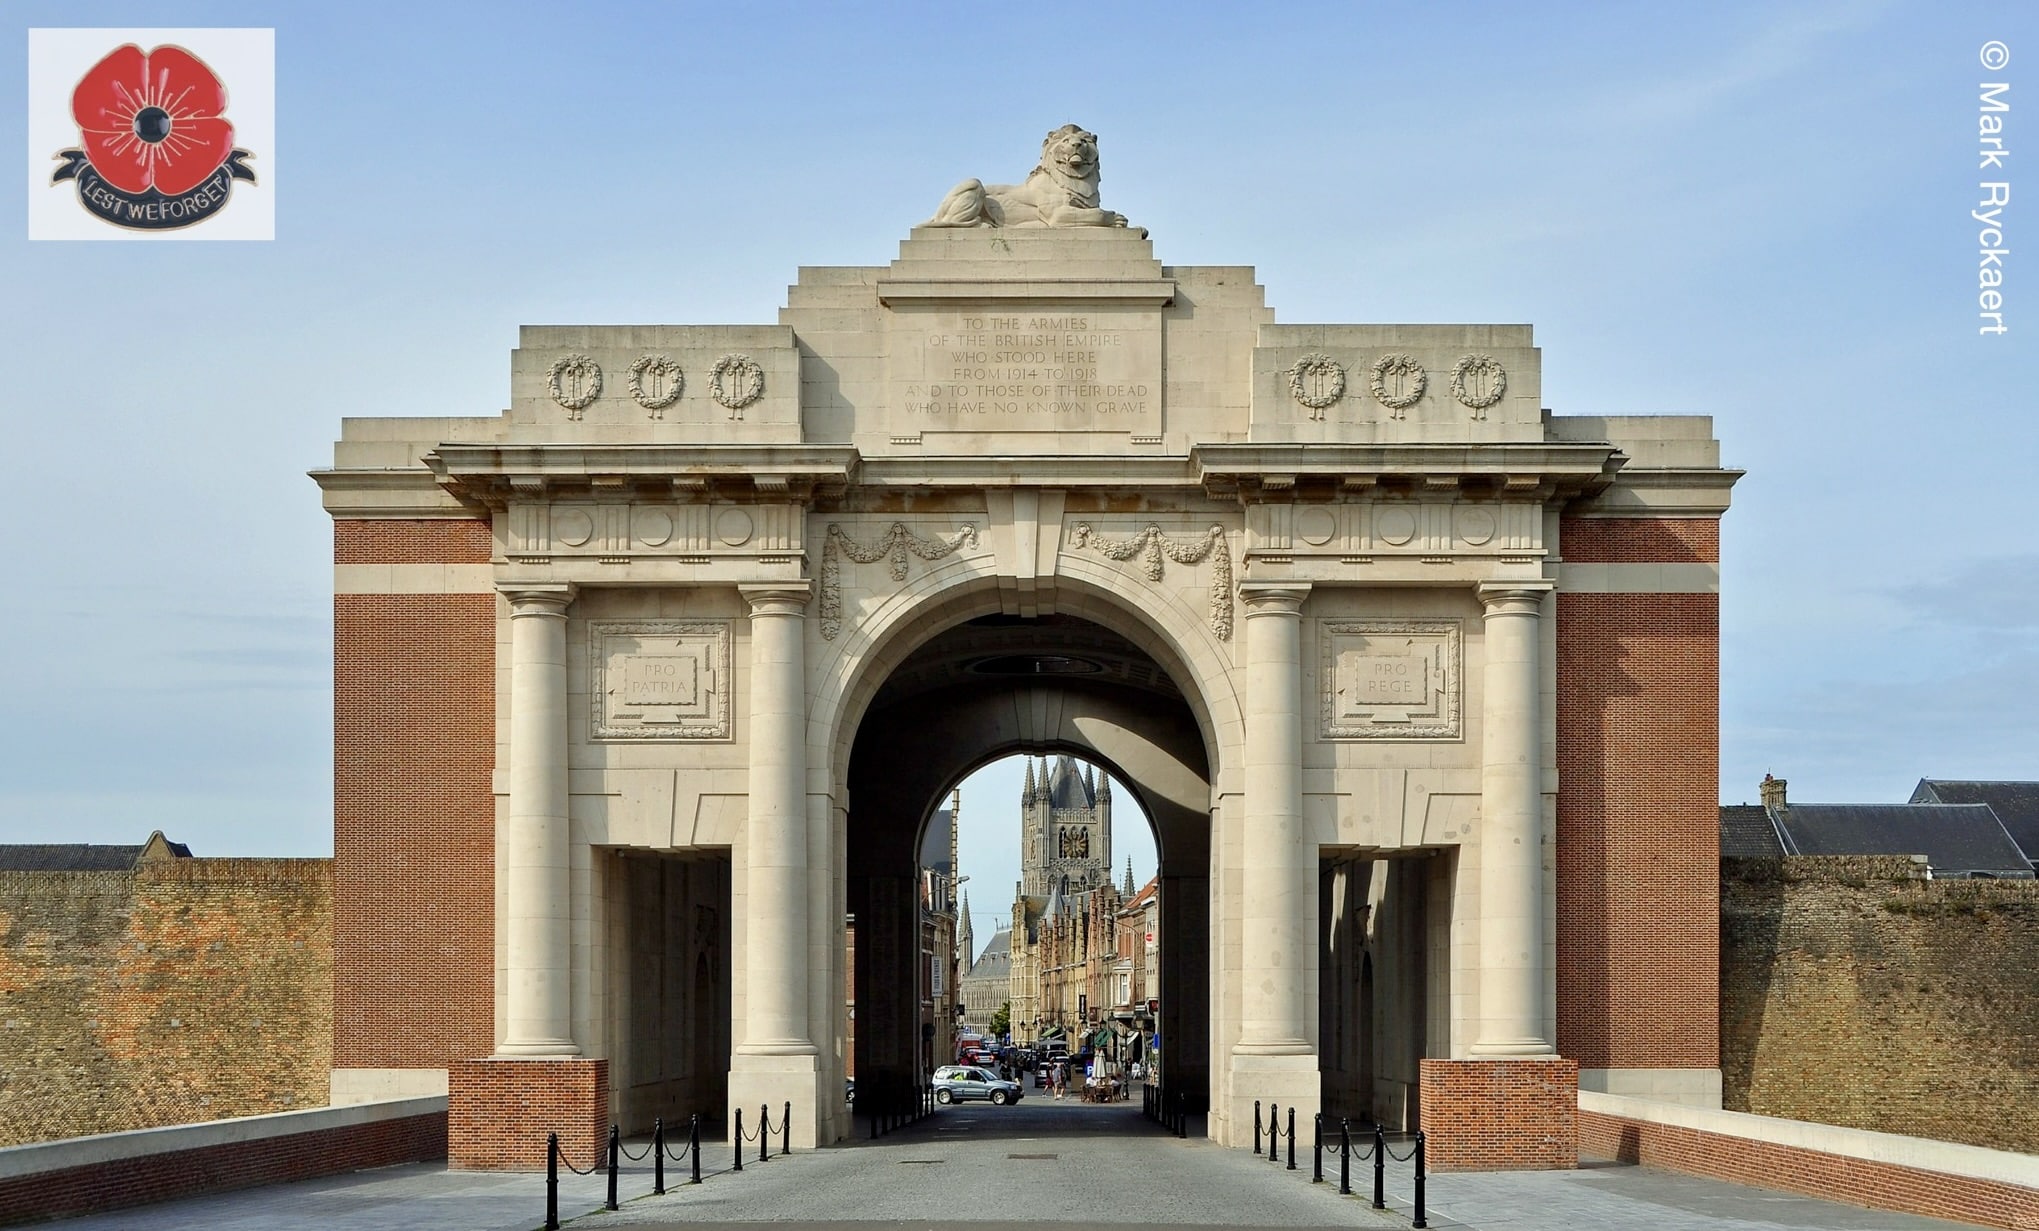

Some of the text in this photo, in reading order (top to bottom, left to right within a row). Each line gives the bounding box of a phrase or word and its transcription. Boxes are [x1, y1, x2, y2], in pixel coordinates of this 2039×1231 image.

[963, 318, 1088, 330] TO THE ARMIES
[929, 334, 1121, 347] OF THE BRITISH EMPIRE
[952, 351, 1096, 364] WHO STOOD HERE
[953, 368, 1097, 380] FROM 1914 TO 1918
[905, 385, 1147, 397] AND TO THOSE OF THEIR DEAD
[905, 402, 1147, 414] WHO HAVE NO KNOWN GRAVE
[1374, 663, 1407, 676] PRO
[632, 681, 688, 693] PATRIA
[1368, 680, 1413, 693] REGE
